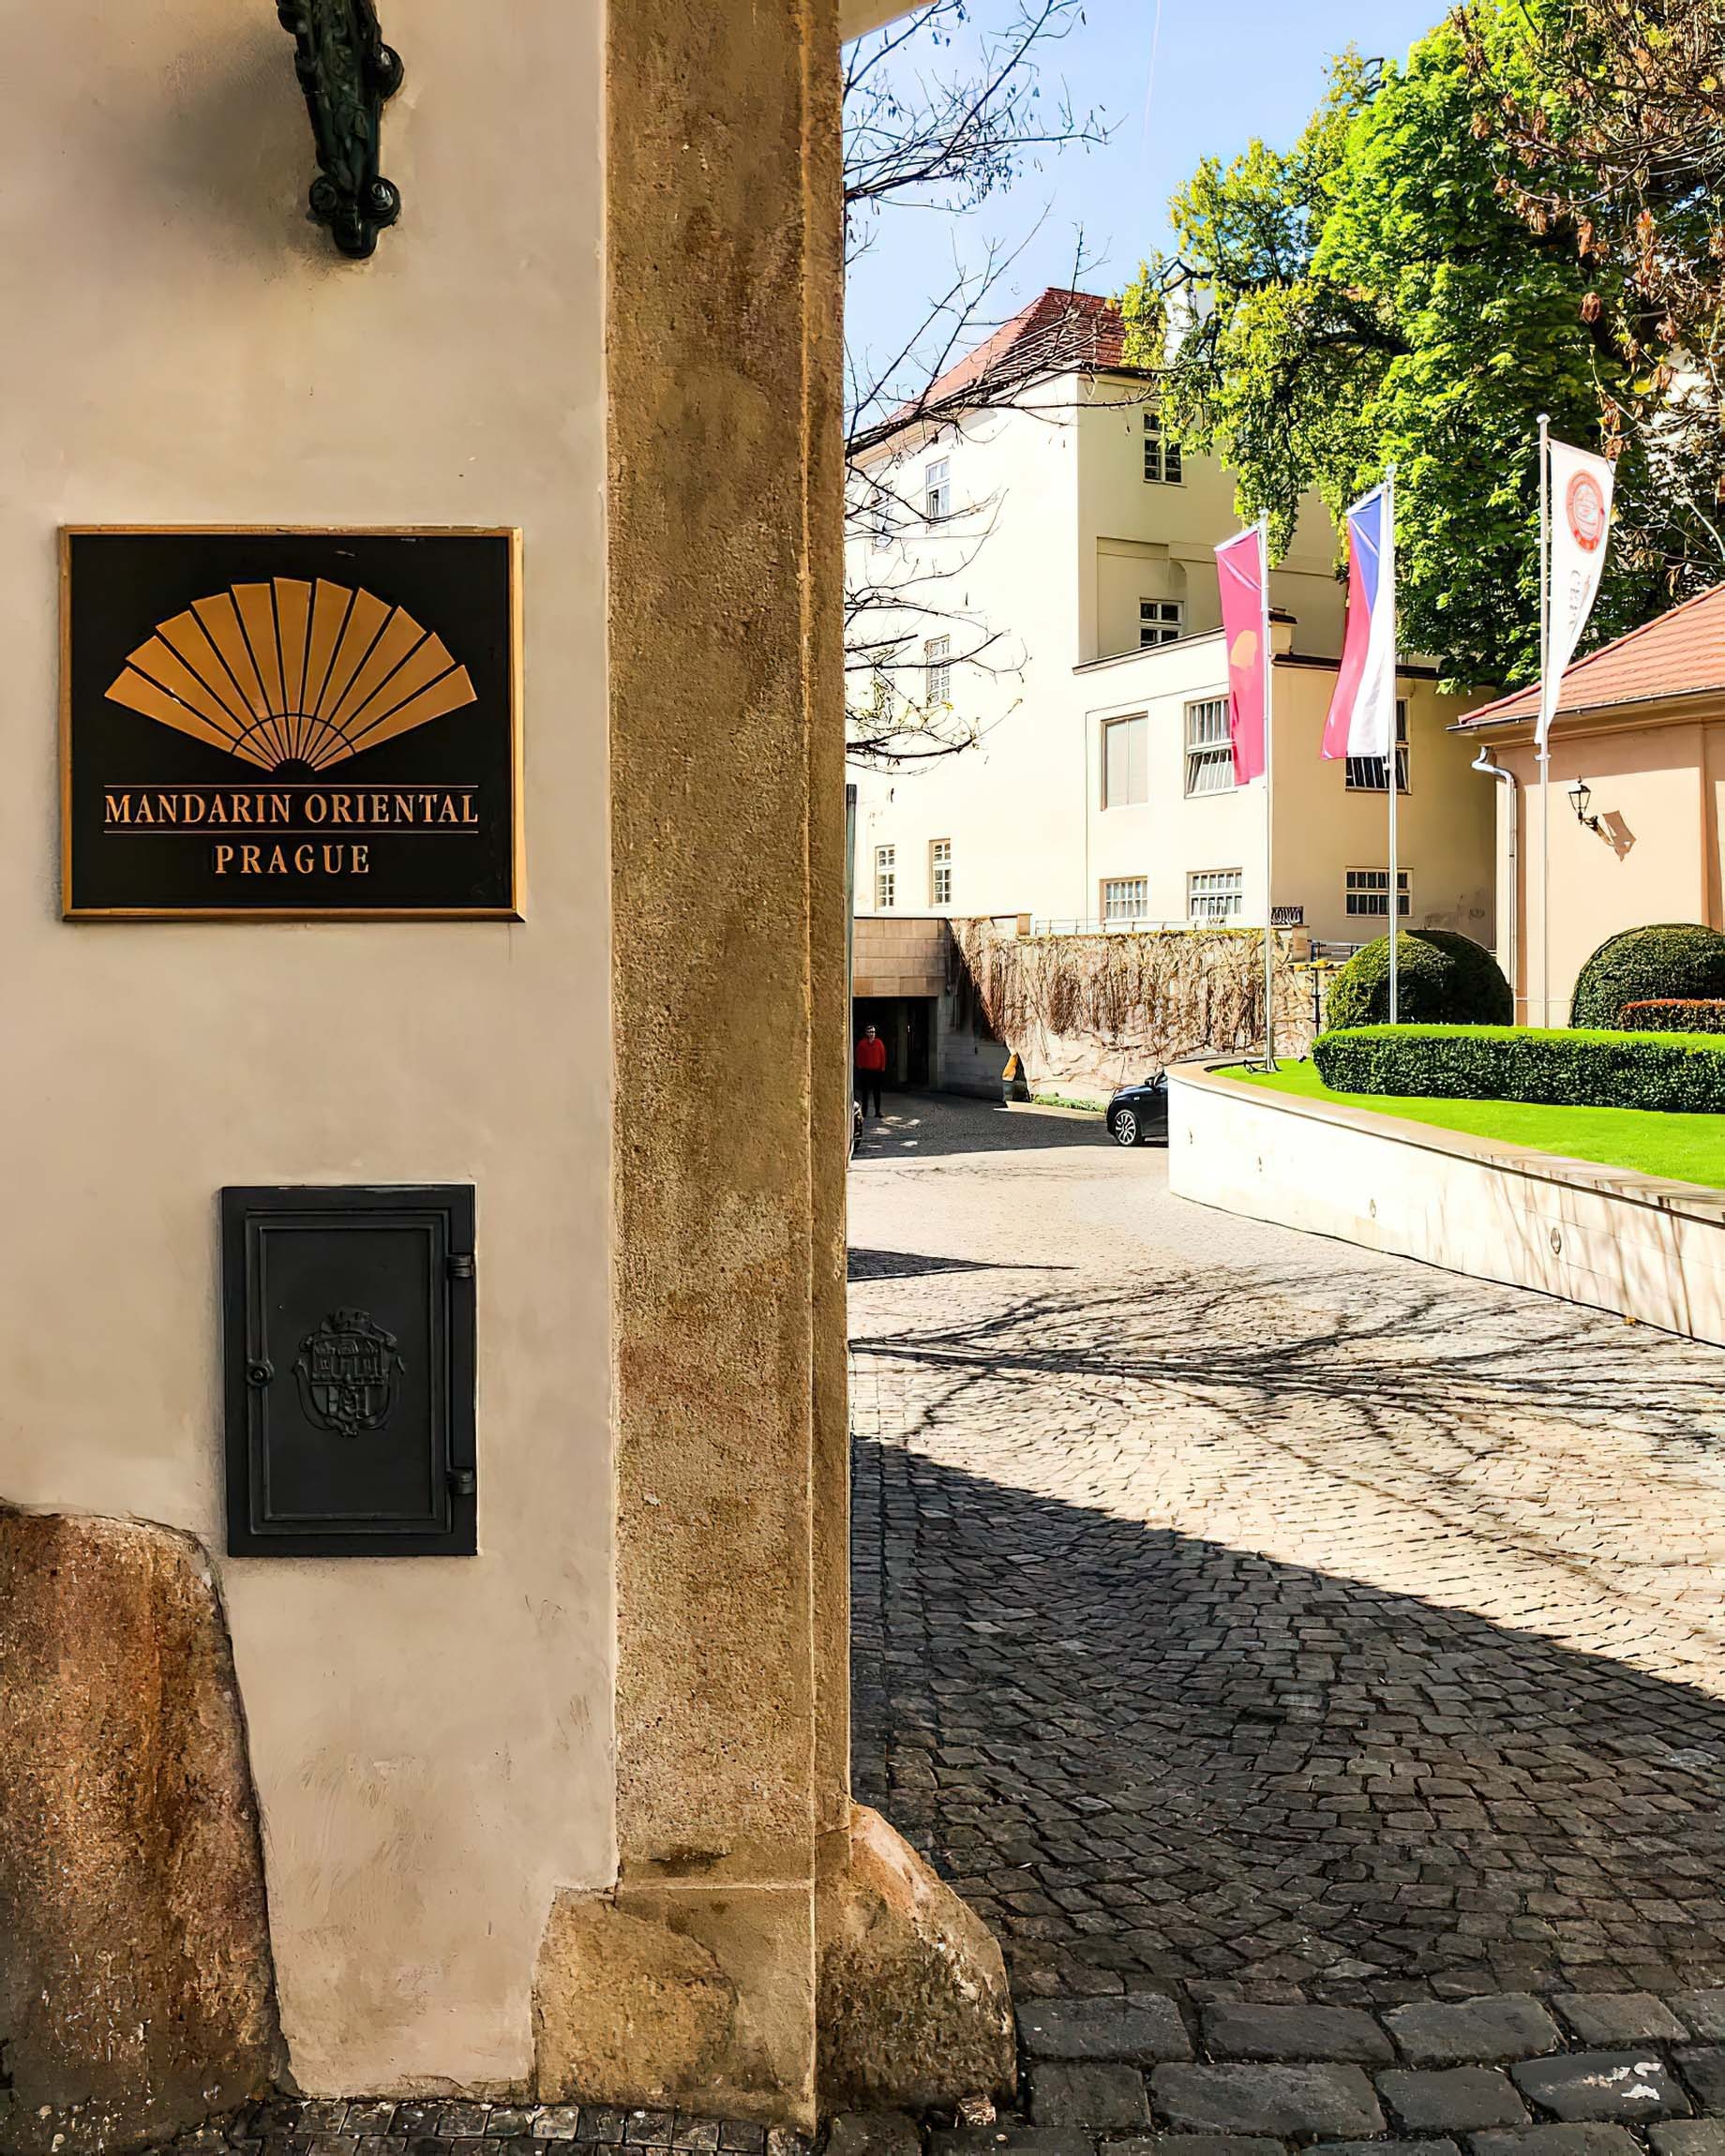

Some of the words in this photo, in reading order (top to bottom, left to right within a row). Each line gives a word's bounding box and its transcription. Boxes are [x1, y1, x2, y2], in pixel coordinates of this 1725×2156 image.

[105, 794, 291, 823] MANDARIN
[305, 794, 479, 823] ORIENTAL
[215, 845, 369, 874] PRAGUE
